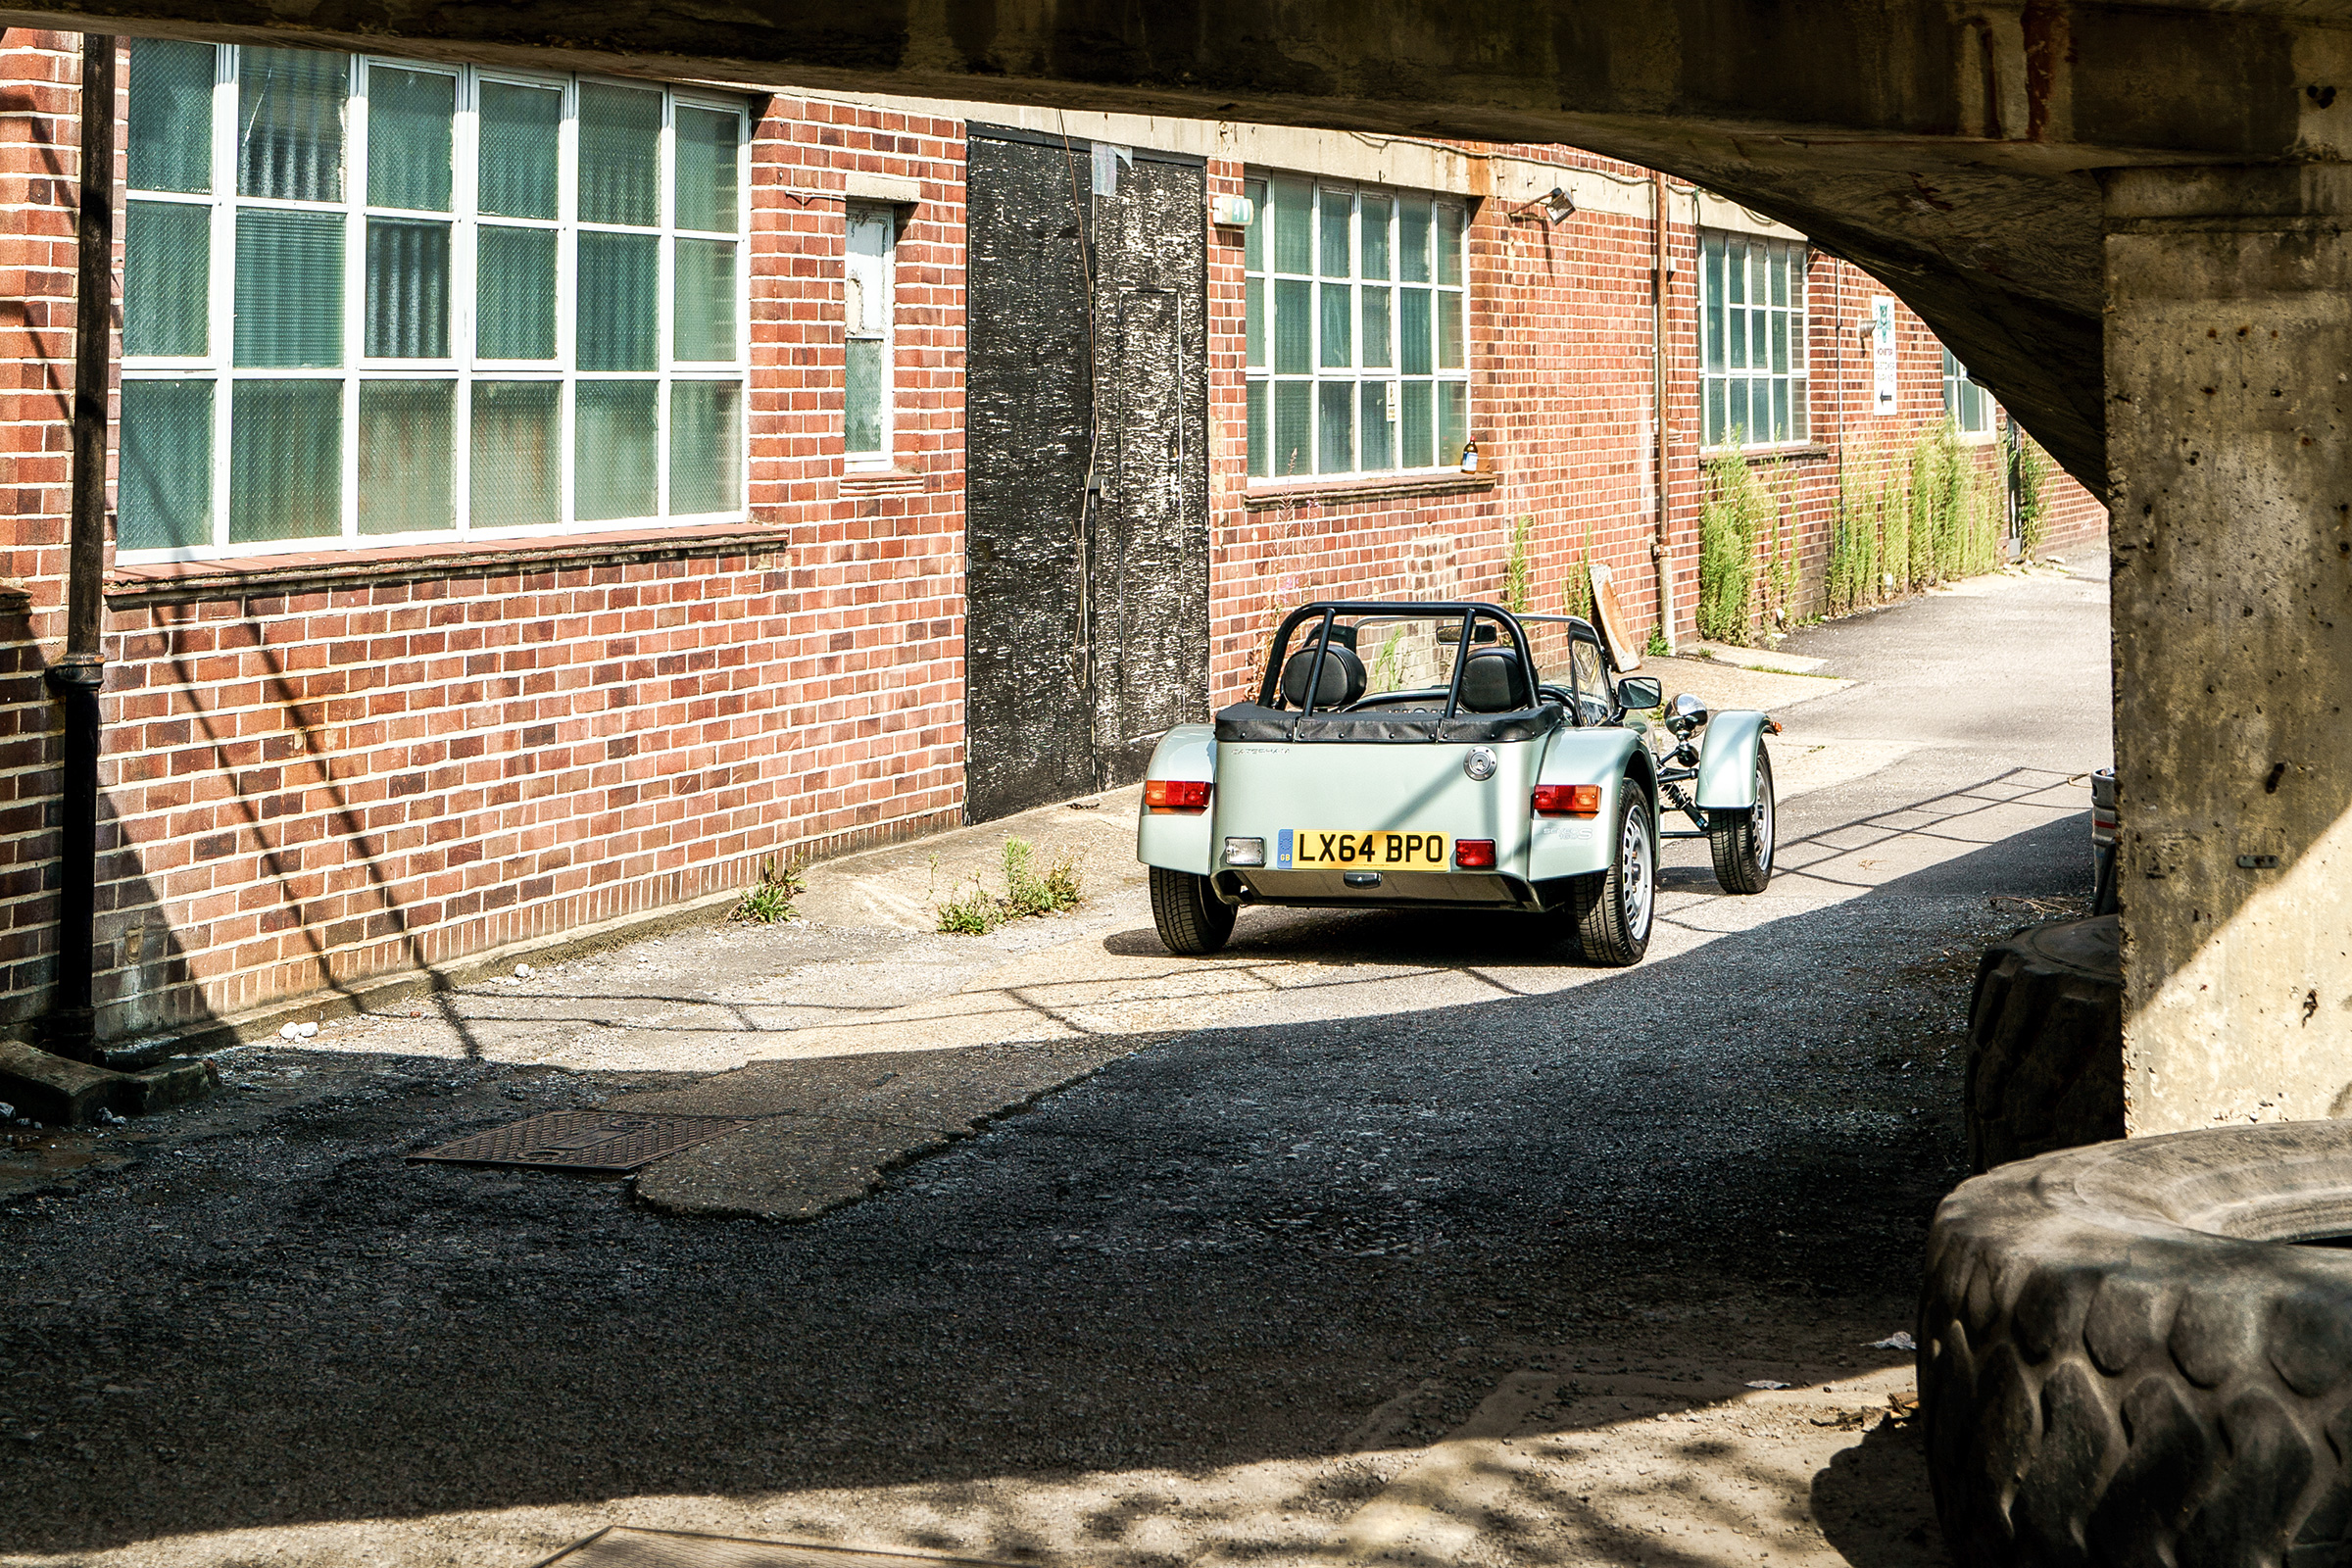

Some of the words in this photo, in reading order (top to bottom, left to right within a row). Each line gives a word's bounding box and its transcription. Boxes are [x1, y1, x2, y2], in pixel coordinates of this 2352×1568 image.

[1298, 833, 1376, 862] LX64
[1385, 834, 1444, 863] BPO
[1280, 854, 1291, 862] GB
